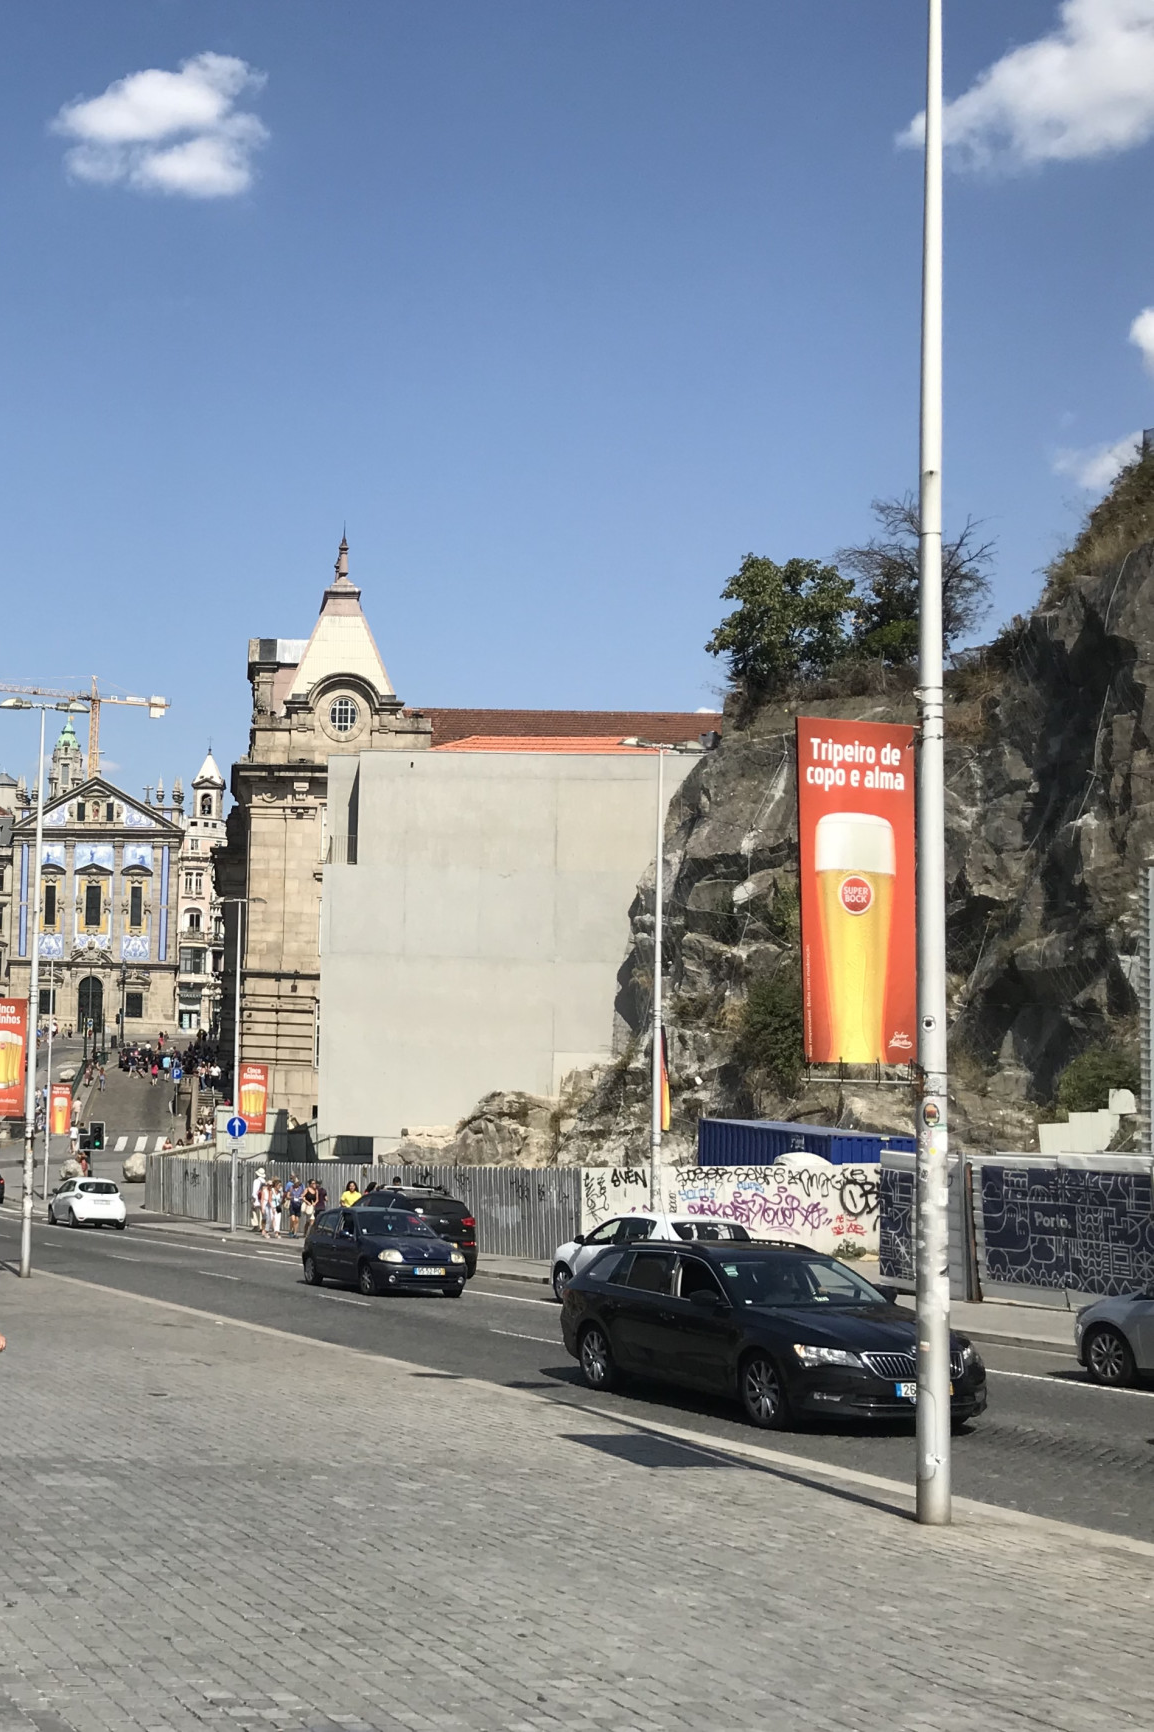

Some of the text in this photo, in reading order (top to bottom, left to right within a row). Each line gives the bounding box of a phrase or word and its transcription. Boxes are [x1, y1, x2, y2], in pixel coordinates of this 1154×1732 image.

[810, 738, 901, 768] Tripeiro de
[806, 766, 905, 792] copo e alma
[843, 886, 869, 895] SUPER
[844, 894, 867, 903] BOCK
[173, 1069, 181, 1078] P
